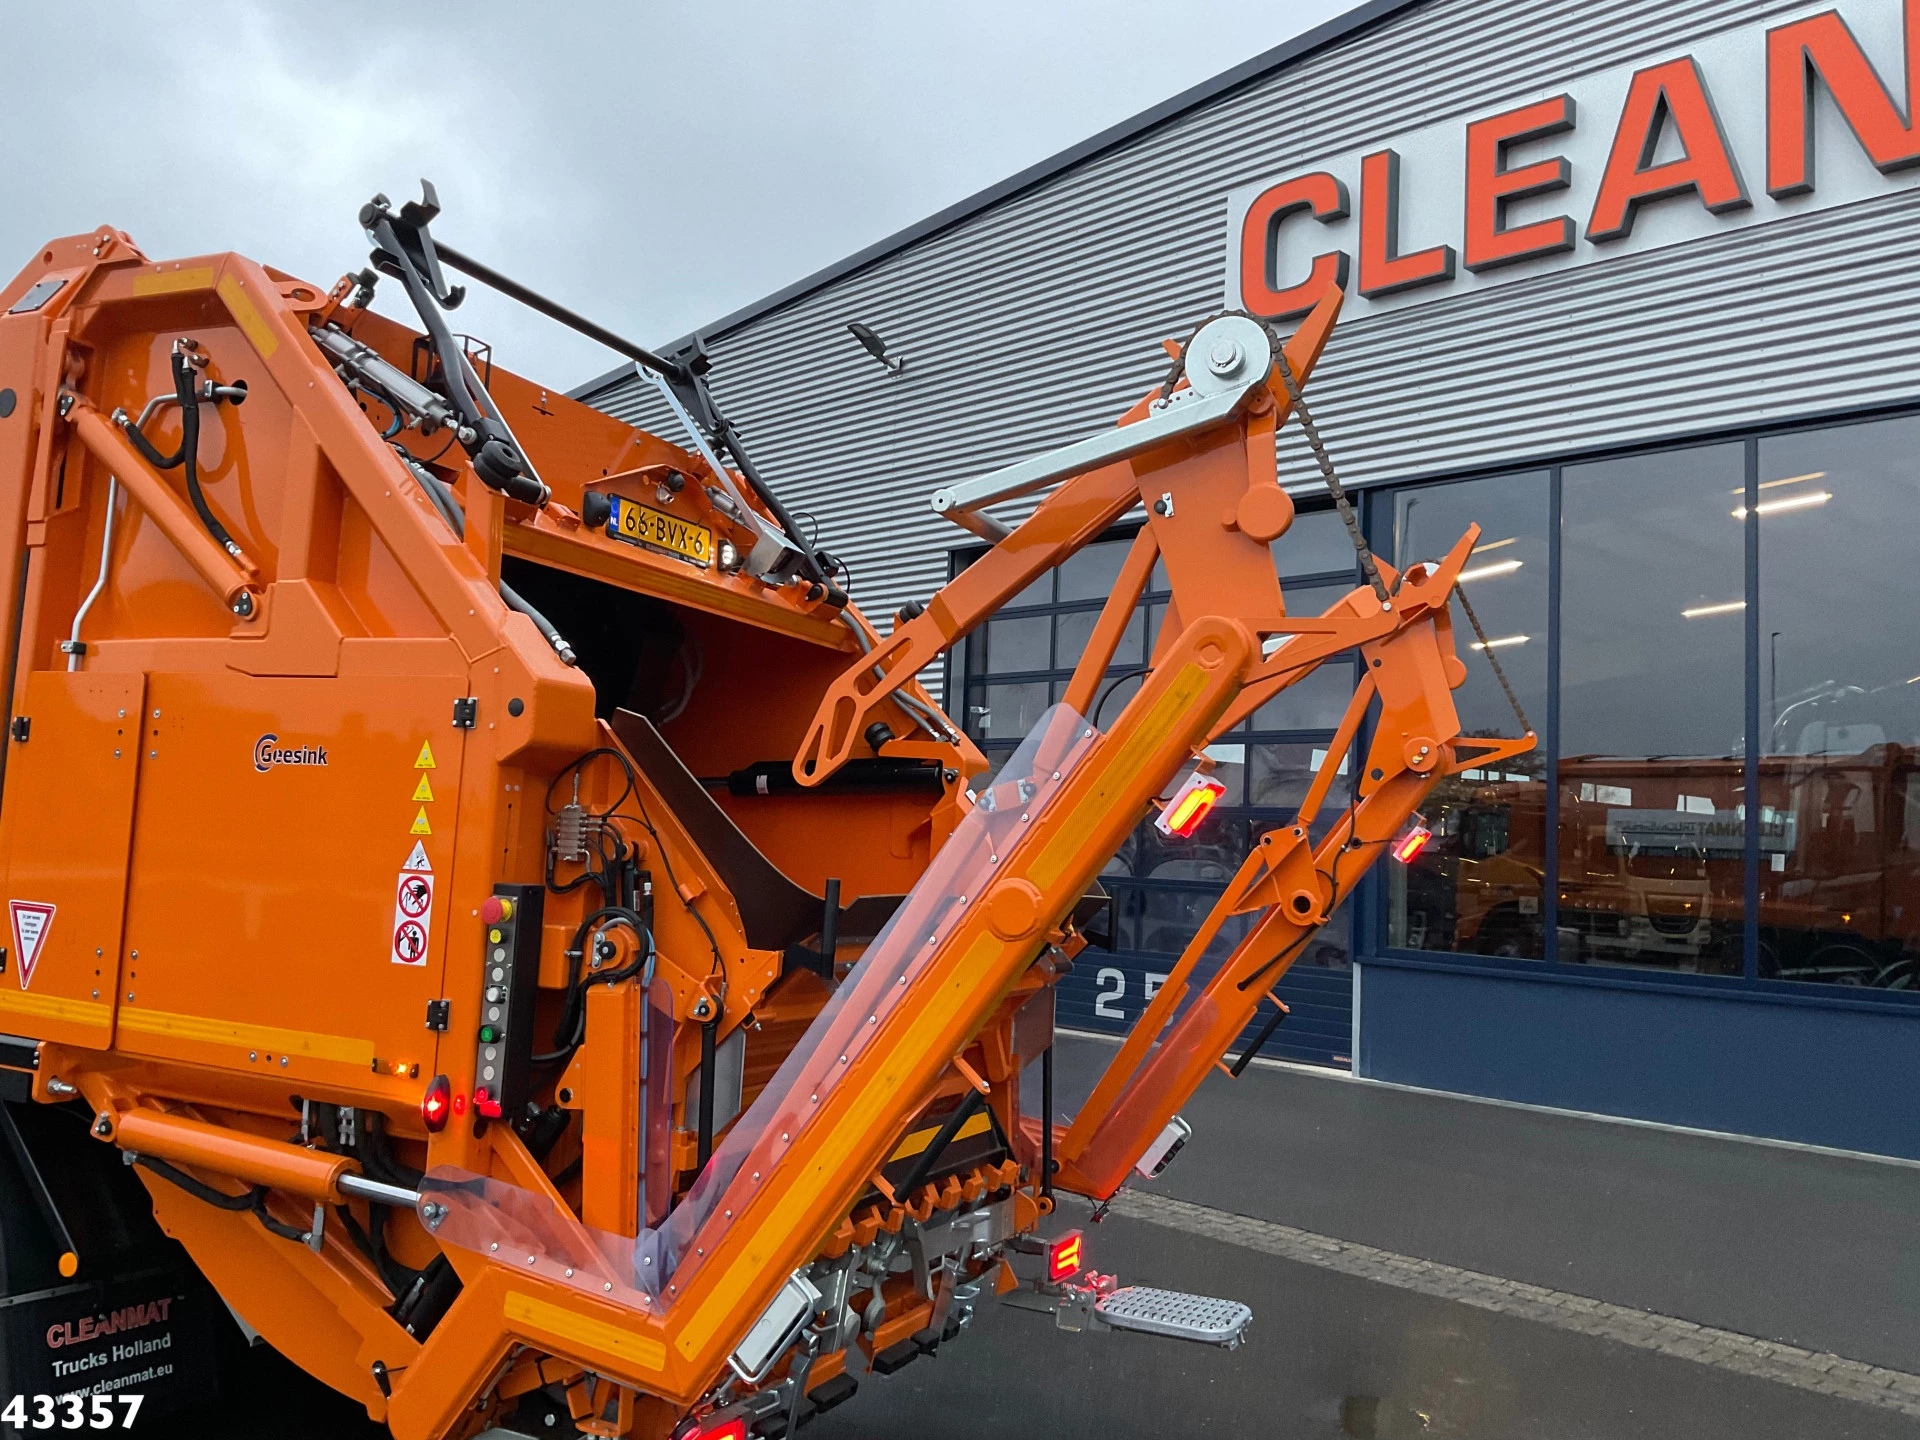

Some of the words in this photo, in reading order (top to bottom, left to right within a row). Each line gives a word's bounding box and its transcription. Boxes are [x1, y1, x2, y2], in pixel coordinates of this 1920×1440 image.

[1240, 0, 1920, 324] CLEAN
[610, 516, 619, 527] NL
[625, 506, 704, 555] 66-BVX-6
[254, 733, 328, 772] Geesink
[46, 1298, 173, 1349] CLEANMAT
[52, 1352, 108, 1378] Trucks
[113, 1332, 171, 1362] Holland
